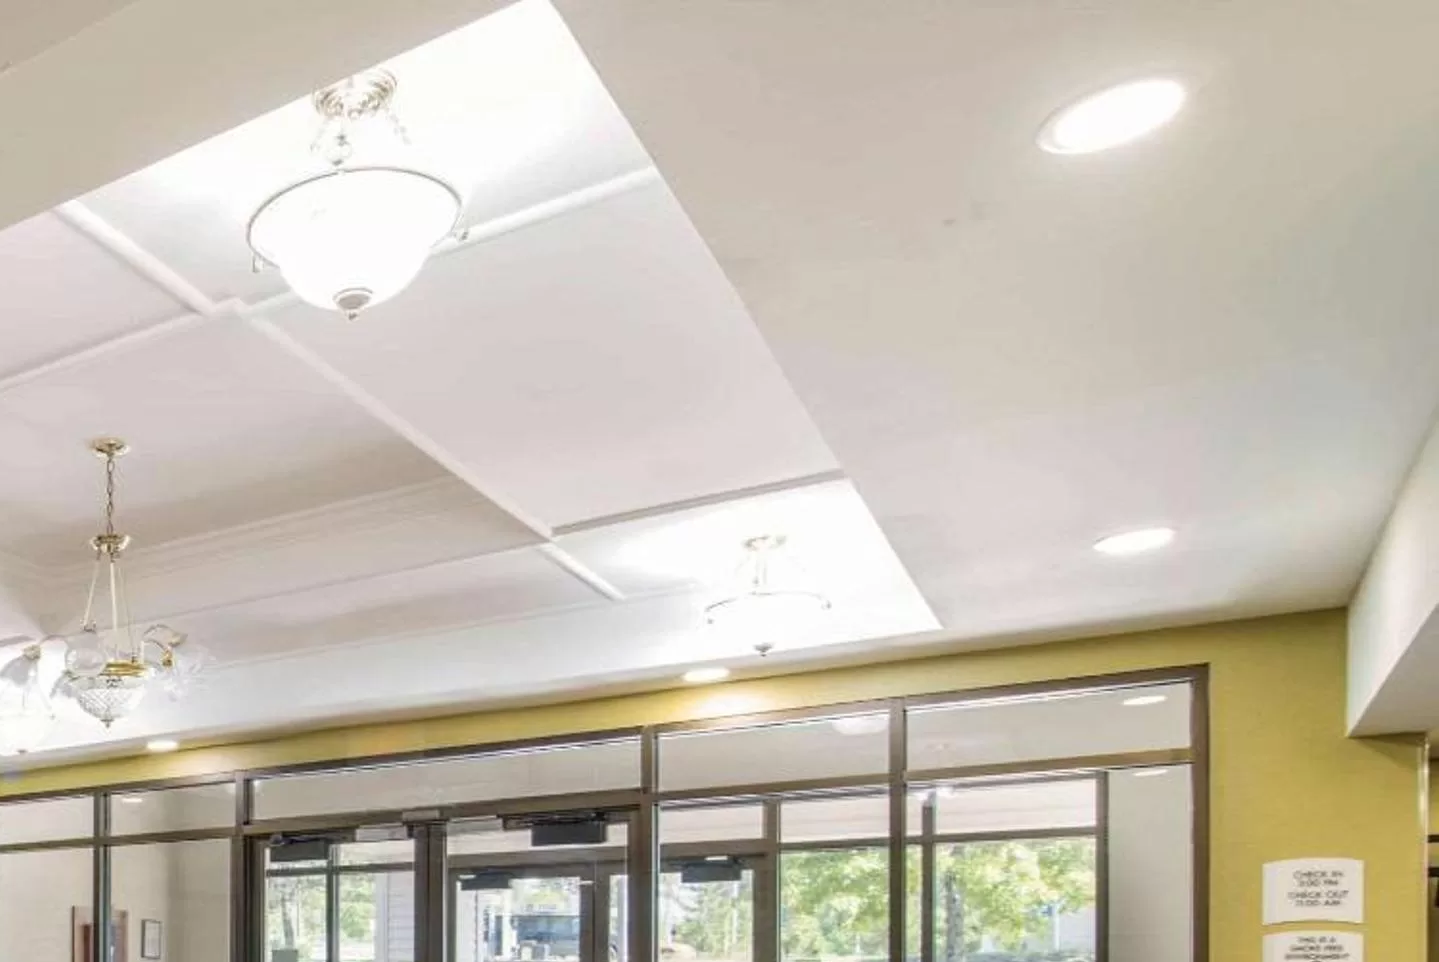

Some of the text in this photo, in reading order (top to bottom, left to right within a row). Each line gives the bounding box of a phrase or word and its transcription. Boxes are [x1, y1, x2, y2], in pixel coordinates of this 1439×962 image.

[1292, 870, 1327, 878] CHECK
[1287, 890, 1349, 899] CHECK OUT
